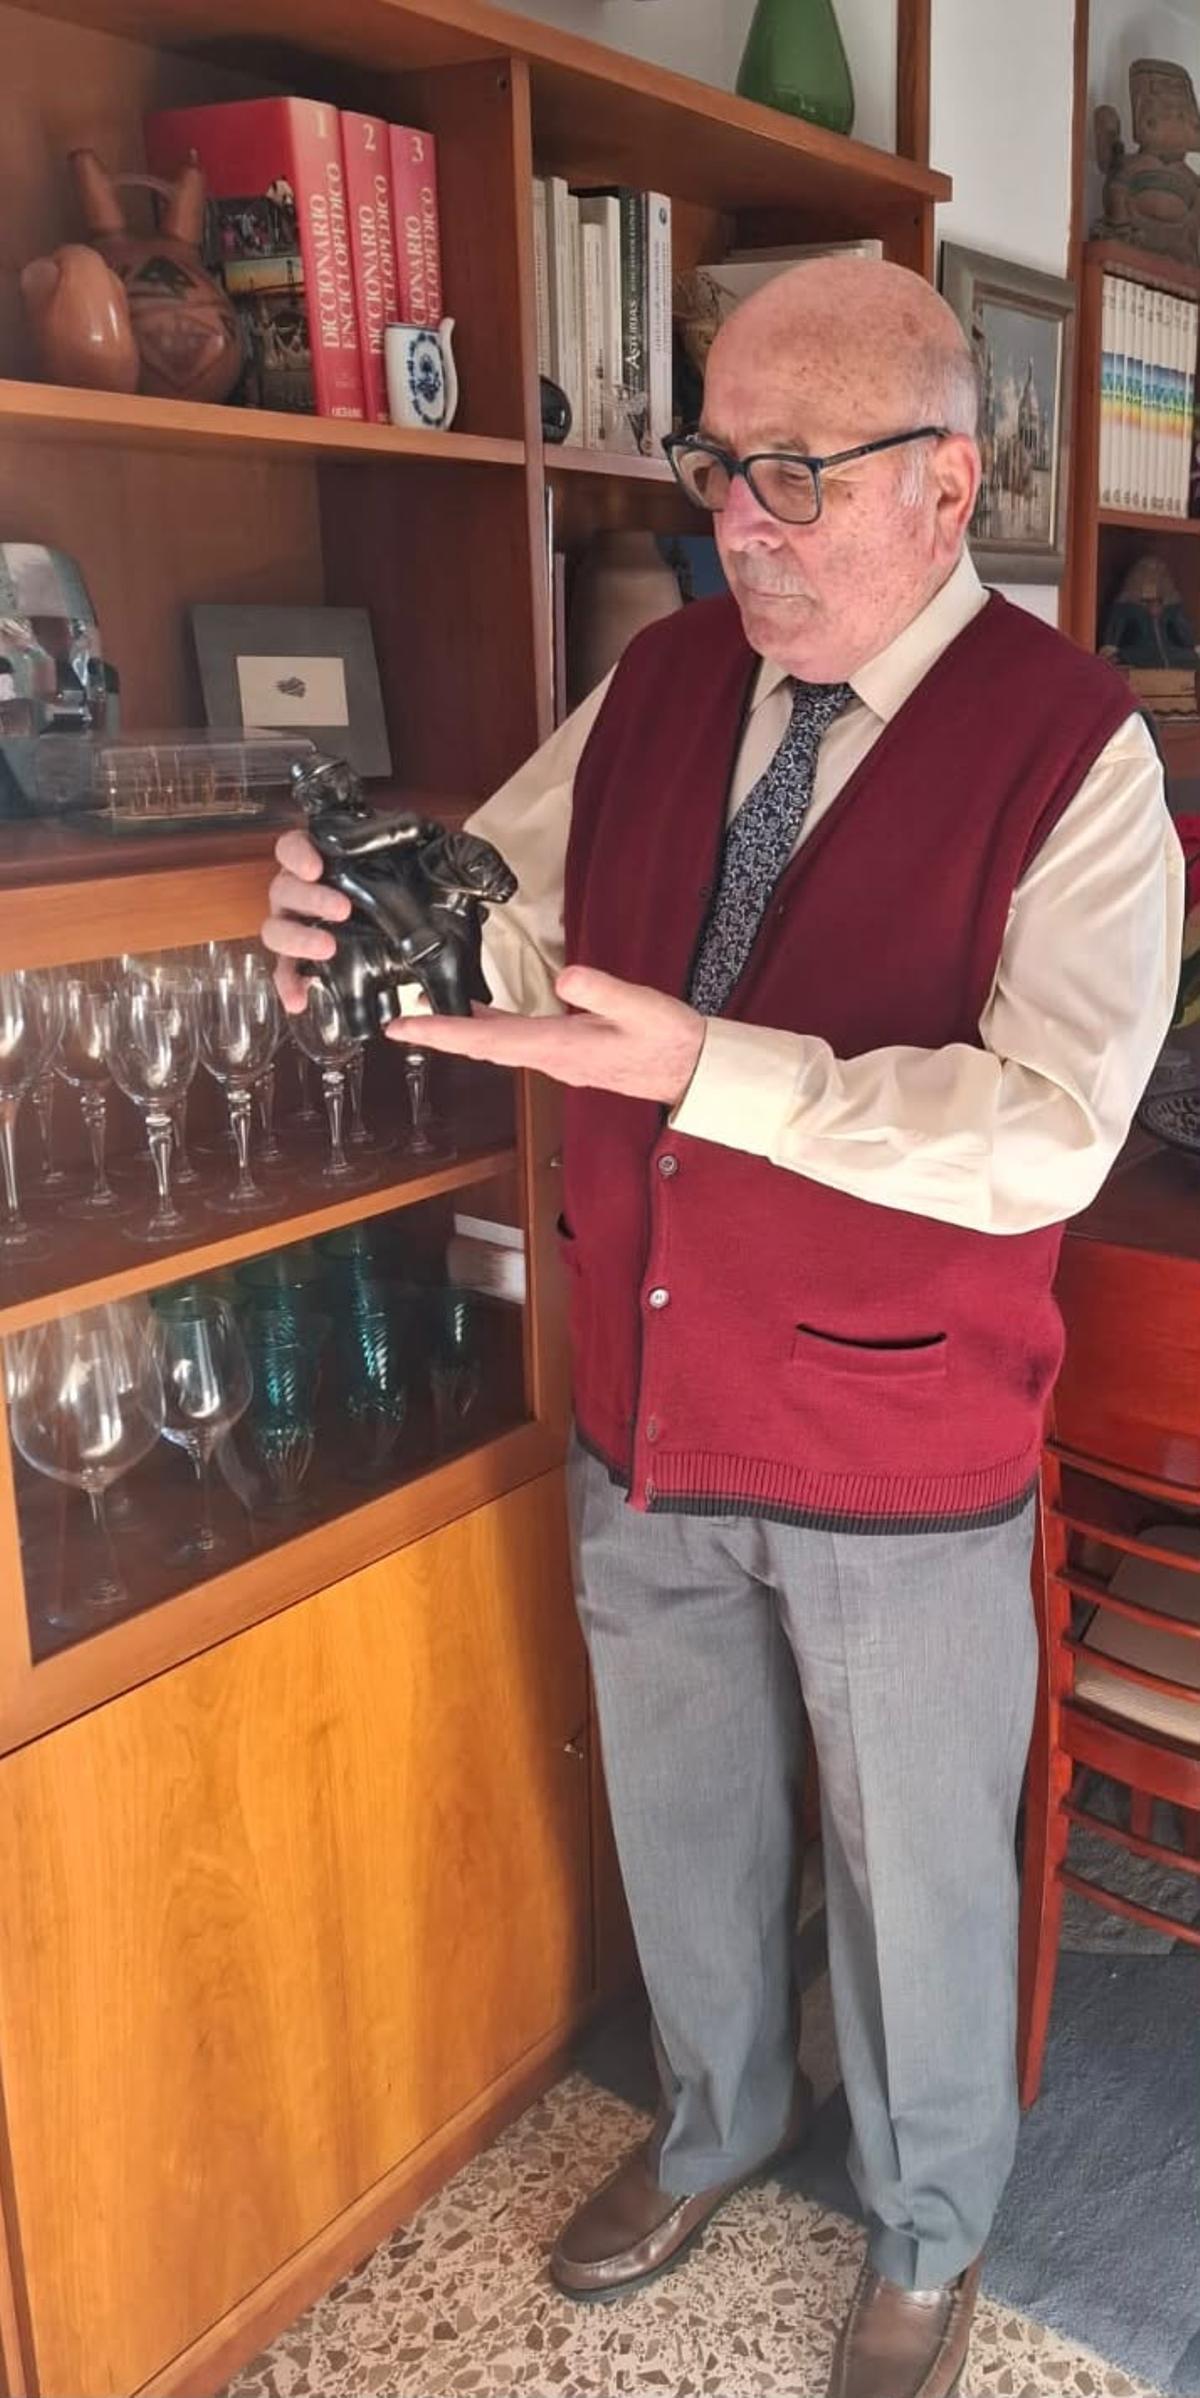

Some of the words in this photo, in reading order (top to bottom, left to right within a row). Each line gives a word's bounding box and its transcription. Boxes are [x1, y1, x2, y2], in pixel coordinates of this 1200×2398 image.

[314, 110, 328, 139] 1
[363, 123, 377, 151] 2
[411, 136, 425, 162] 3
[310, 193, 341, 349] DICCIONARIO
[359, 205, 386, 354] DICCIONARIO
[405, 215, 428, 325] CIONARIO
